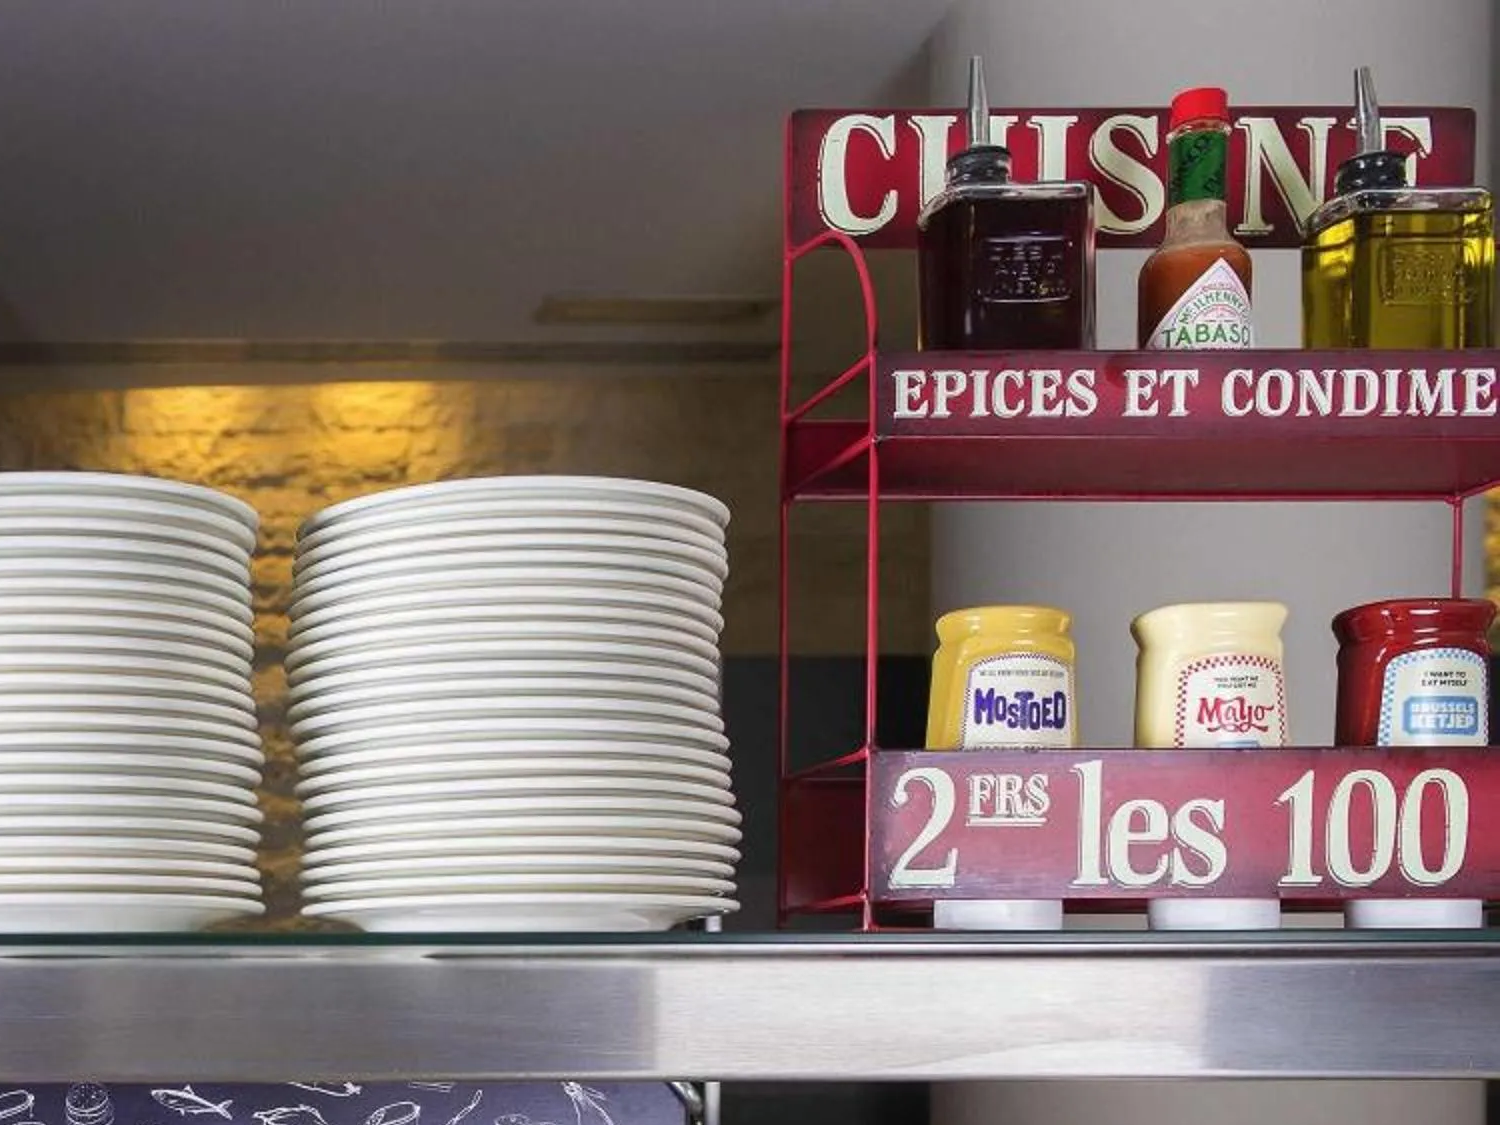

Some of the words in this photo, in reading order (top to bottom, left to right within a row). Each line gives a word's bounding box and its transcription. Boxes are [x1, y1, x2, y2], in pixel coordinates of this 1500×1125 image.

[892, 369, 1099, 419] EPICES
[1122, 368, 1200, 418] ET
[1221, 367, 1498, 418] CONDIME
[1197, 696, 1275, 733] Mayo
[1068, 759, 1228, 888] les
[1270, 768, 1469, 888] 100
